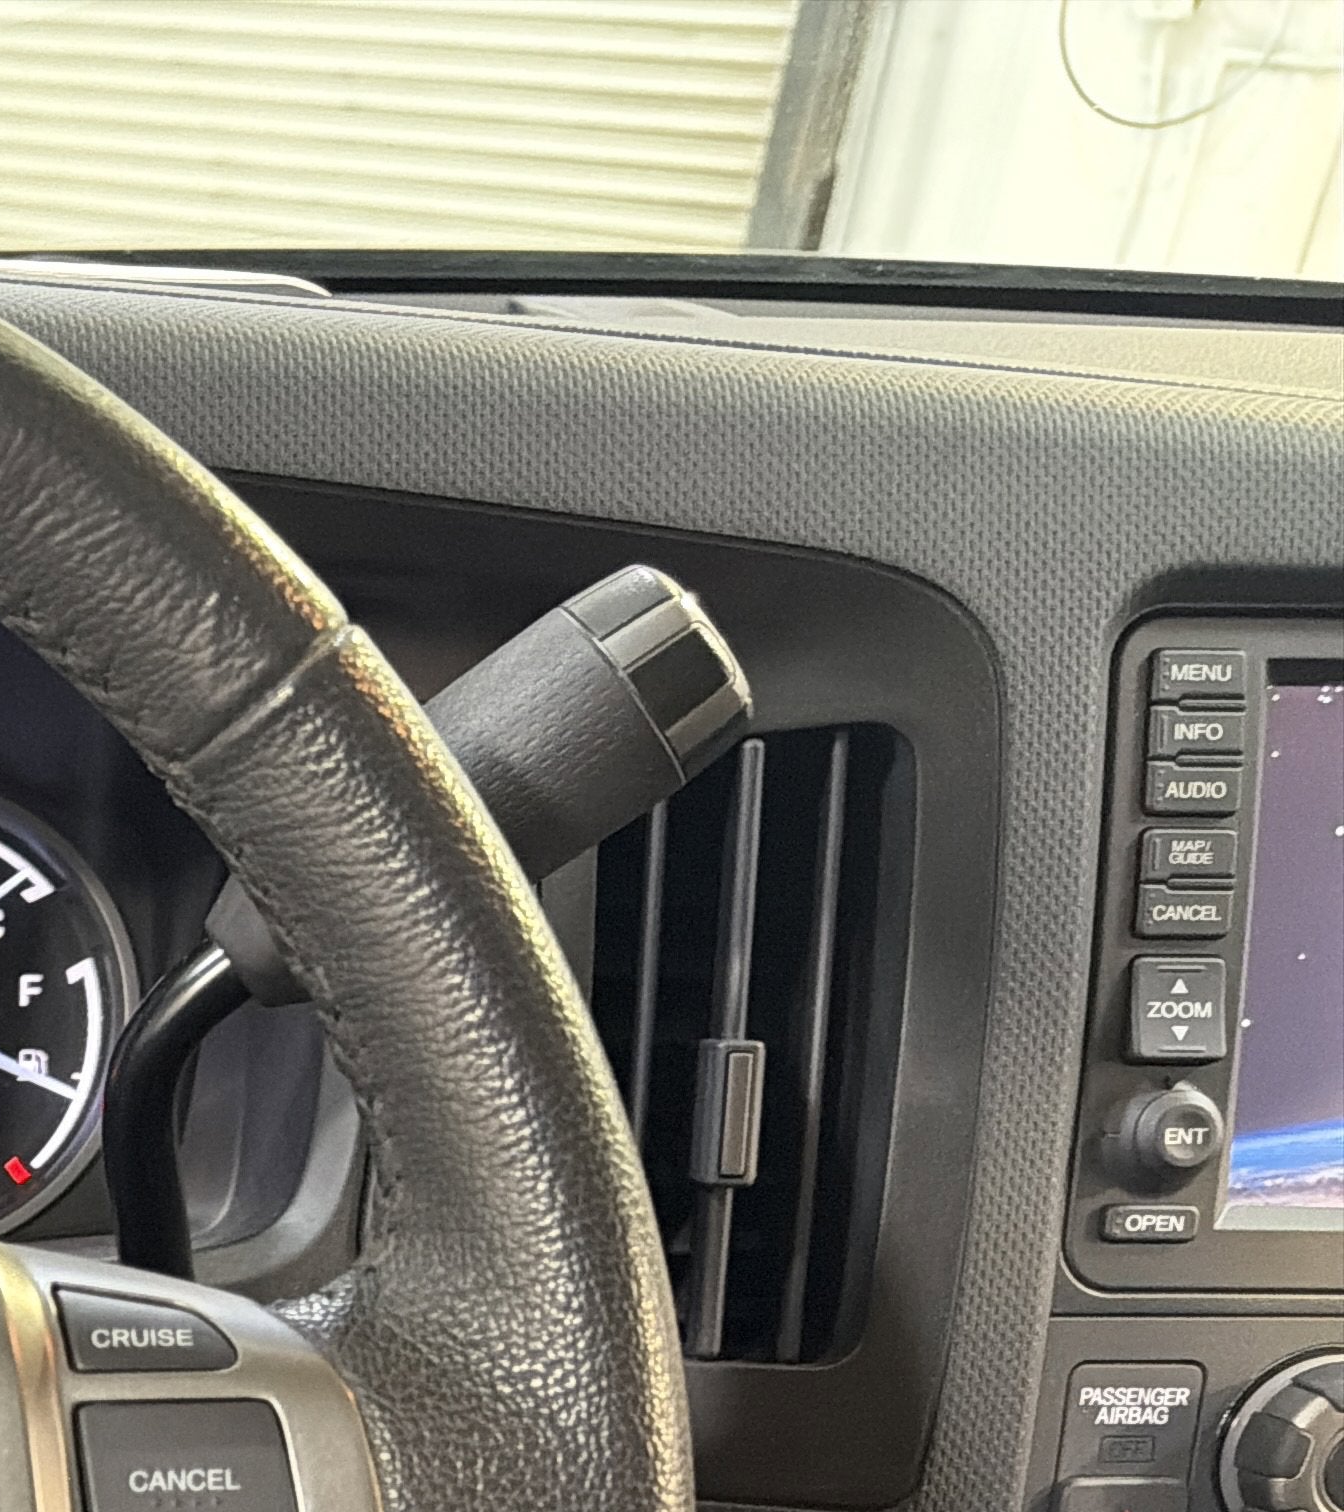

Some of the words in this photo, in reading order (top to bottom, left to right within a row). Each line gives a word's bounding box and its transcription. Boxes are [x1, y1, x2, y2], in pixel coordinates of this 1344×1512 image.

[1170, 663, 1233, 682] MENU
[1174, 722, 1224, 741] INFO
[1164, 781, 1227, 799] AUDIO
[1170, 840, 1212, 853] MAP/
[1168, 851, 1214, 865] GUIDE
[1152, 904, 1222, 922] CANCEL
[18, 973, 43, 1007] F
[1146, 1001, 1213, 1019] ZOOM
[1164, 1127, 1209, 1149] ENT
[1124, 1214, 1186, 1232] OPEN
[91, 1328, 194, 1349] CRUISE
[1078, 1386, 1191, 1407] PASSENGER
[1094, 1405, 1170, 1425] AIRBAG
[128, 1468, 241, 1493] CANCEL
